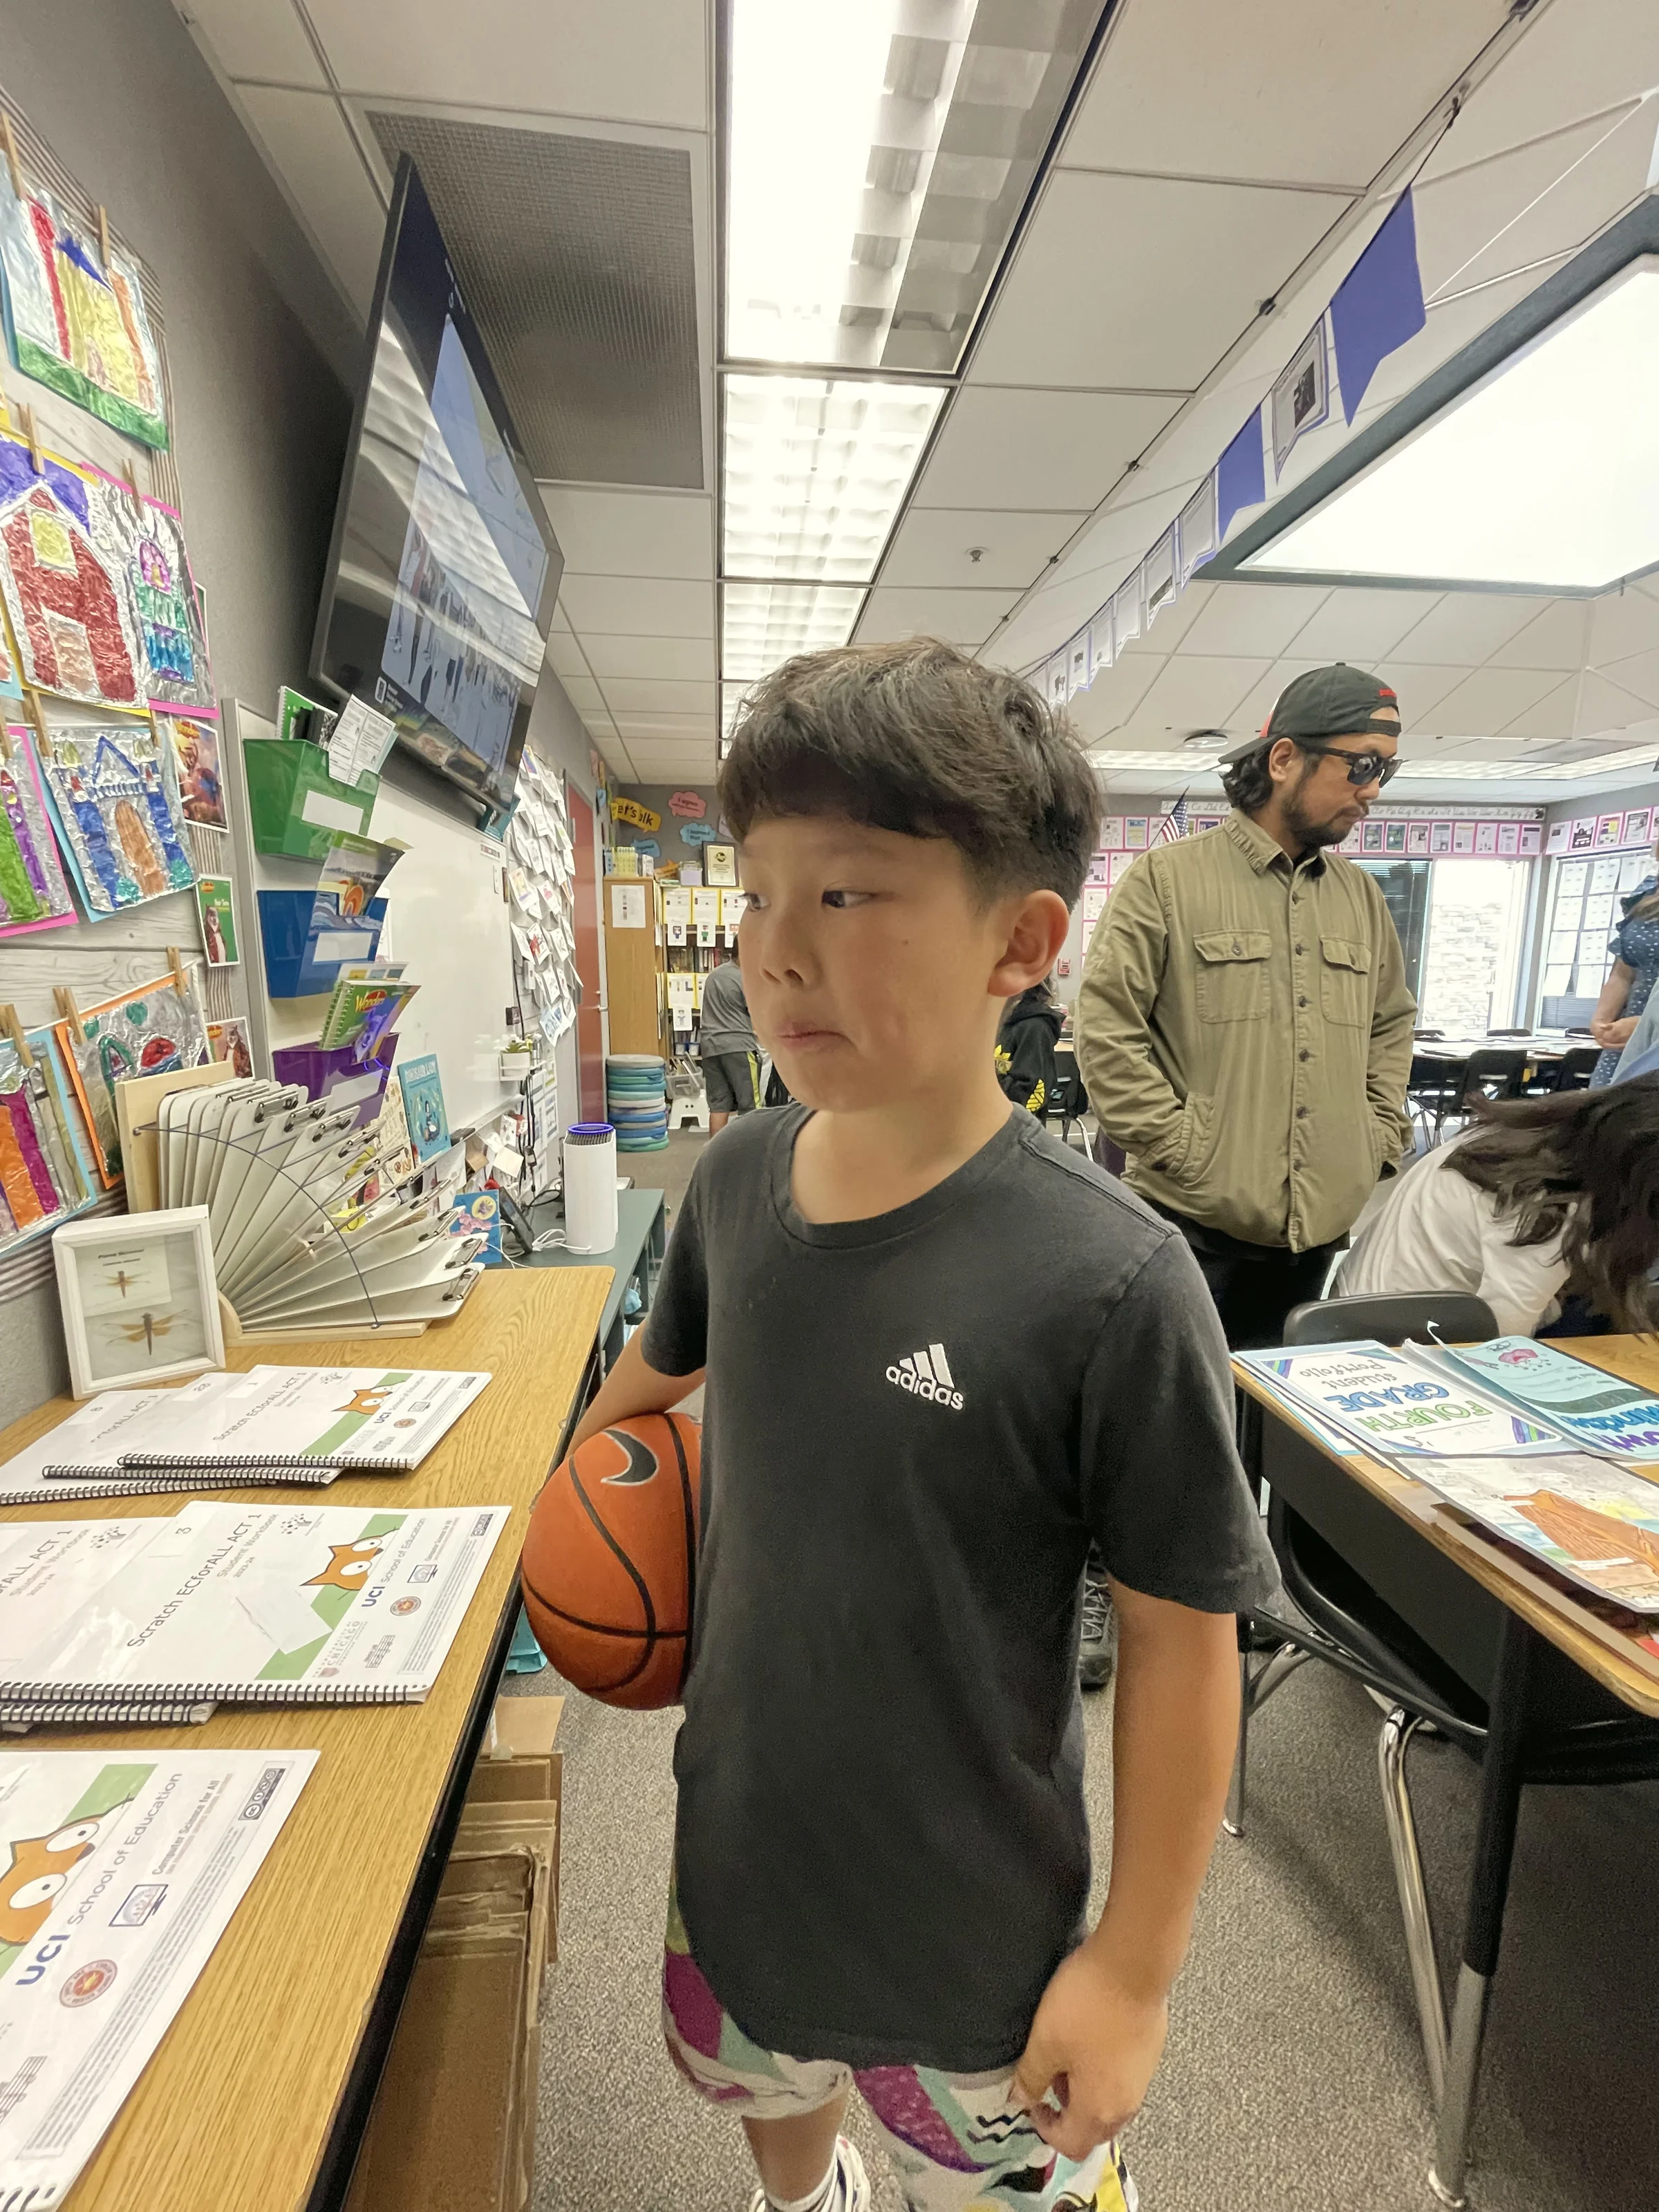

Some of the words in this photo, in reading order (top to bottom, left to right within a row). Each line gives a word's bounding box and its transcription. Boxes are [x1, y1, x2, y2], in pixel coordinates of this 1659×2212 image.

[617, 805, 637, 818] et's
[885, 1366, 964, 1410] adidas
[1323, 1382, 1450, 1412] GRADE
[374, 1412, 391, 1424] UCI
[1355, 1400, 1493, 1432] FOURTH
[30, 1539, 60, 1559] ACT
[216, 1544, 249, 1577] Student
[245, 1513, 278, 1547] Workbook
[361, 1586, 385, 1608] UCI
[381, 1557, 402, 1583] School
[396, 1550, 406, 1562] of
[403, 1518, 427, 1549] Education
[126, 1600, 183, 1647] Scratch
[176, 1545, 234, 1595] ECforALL
[227, 1522, 252, 1542] ACT
[327, 1620, 360, 1666] CHICAGO
[152, 1836, 185, 1875] Computer
[178, 1804, 205, 1835] Science
[199, 1792, 213, 1803] for
[207, 1780, 221, 1790] All
[15, 1935, 71, 1986] UCI
[67, 1870, 116, 1925] School
[114, 1848, 130, 1866] of
[124, 1773, 182, 1846] Education
